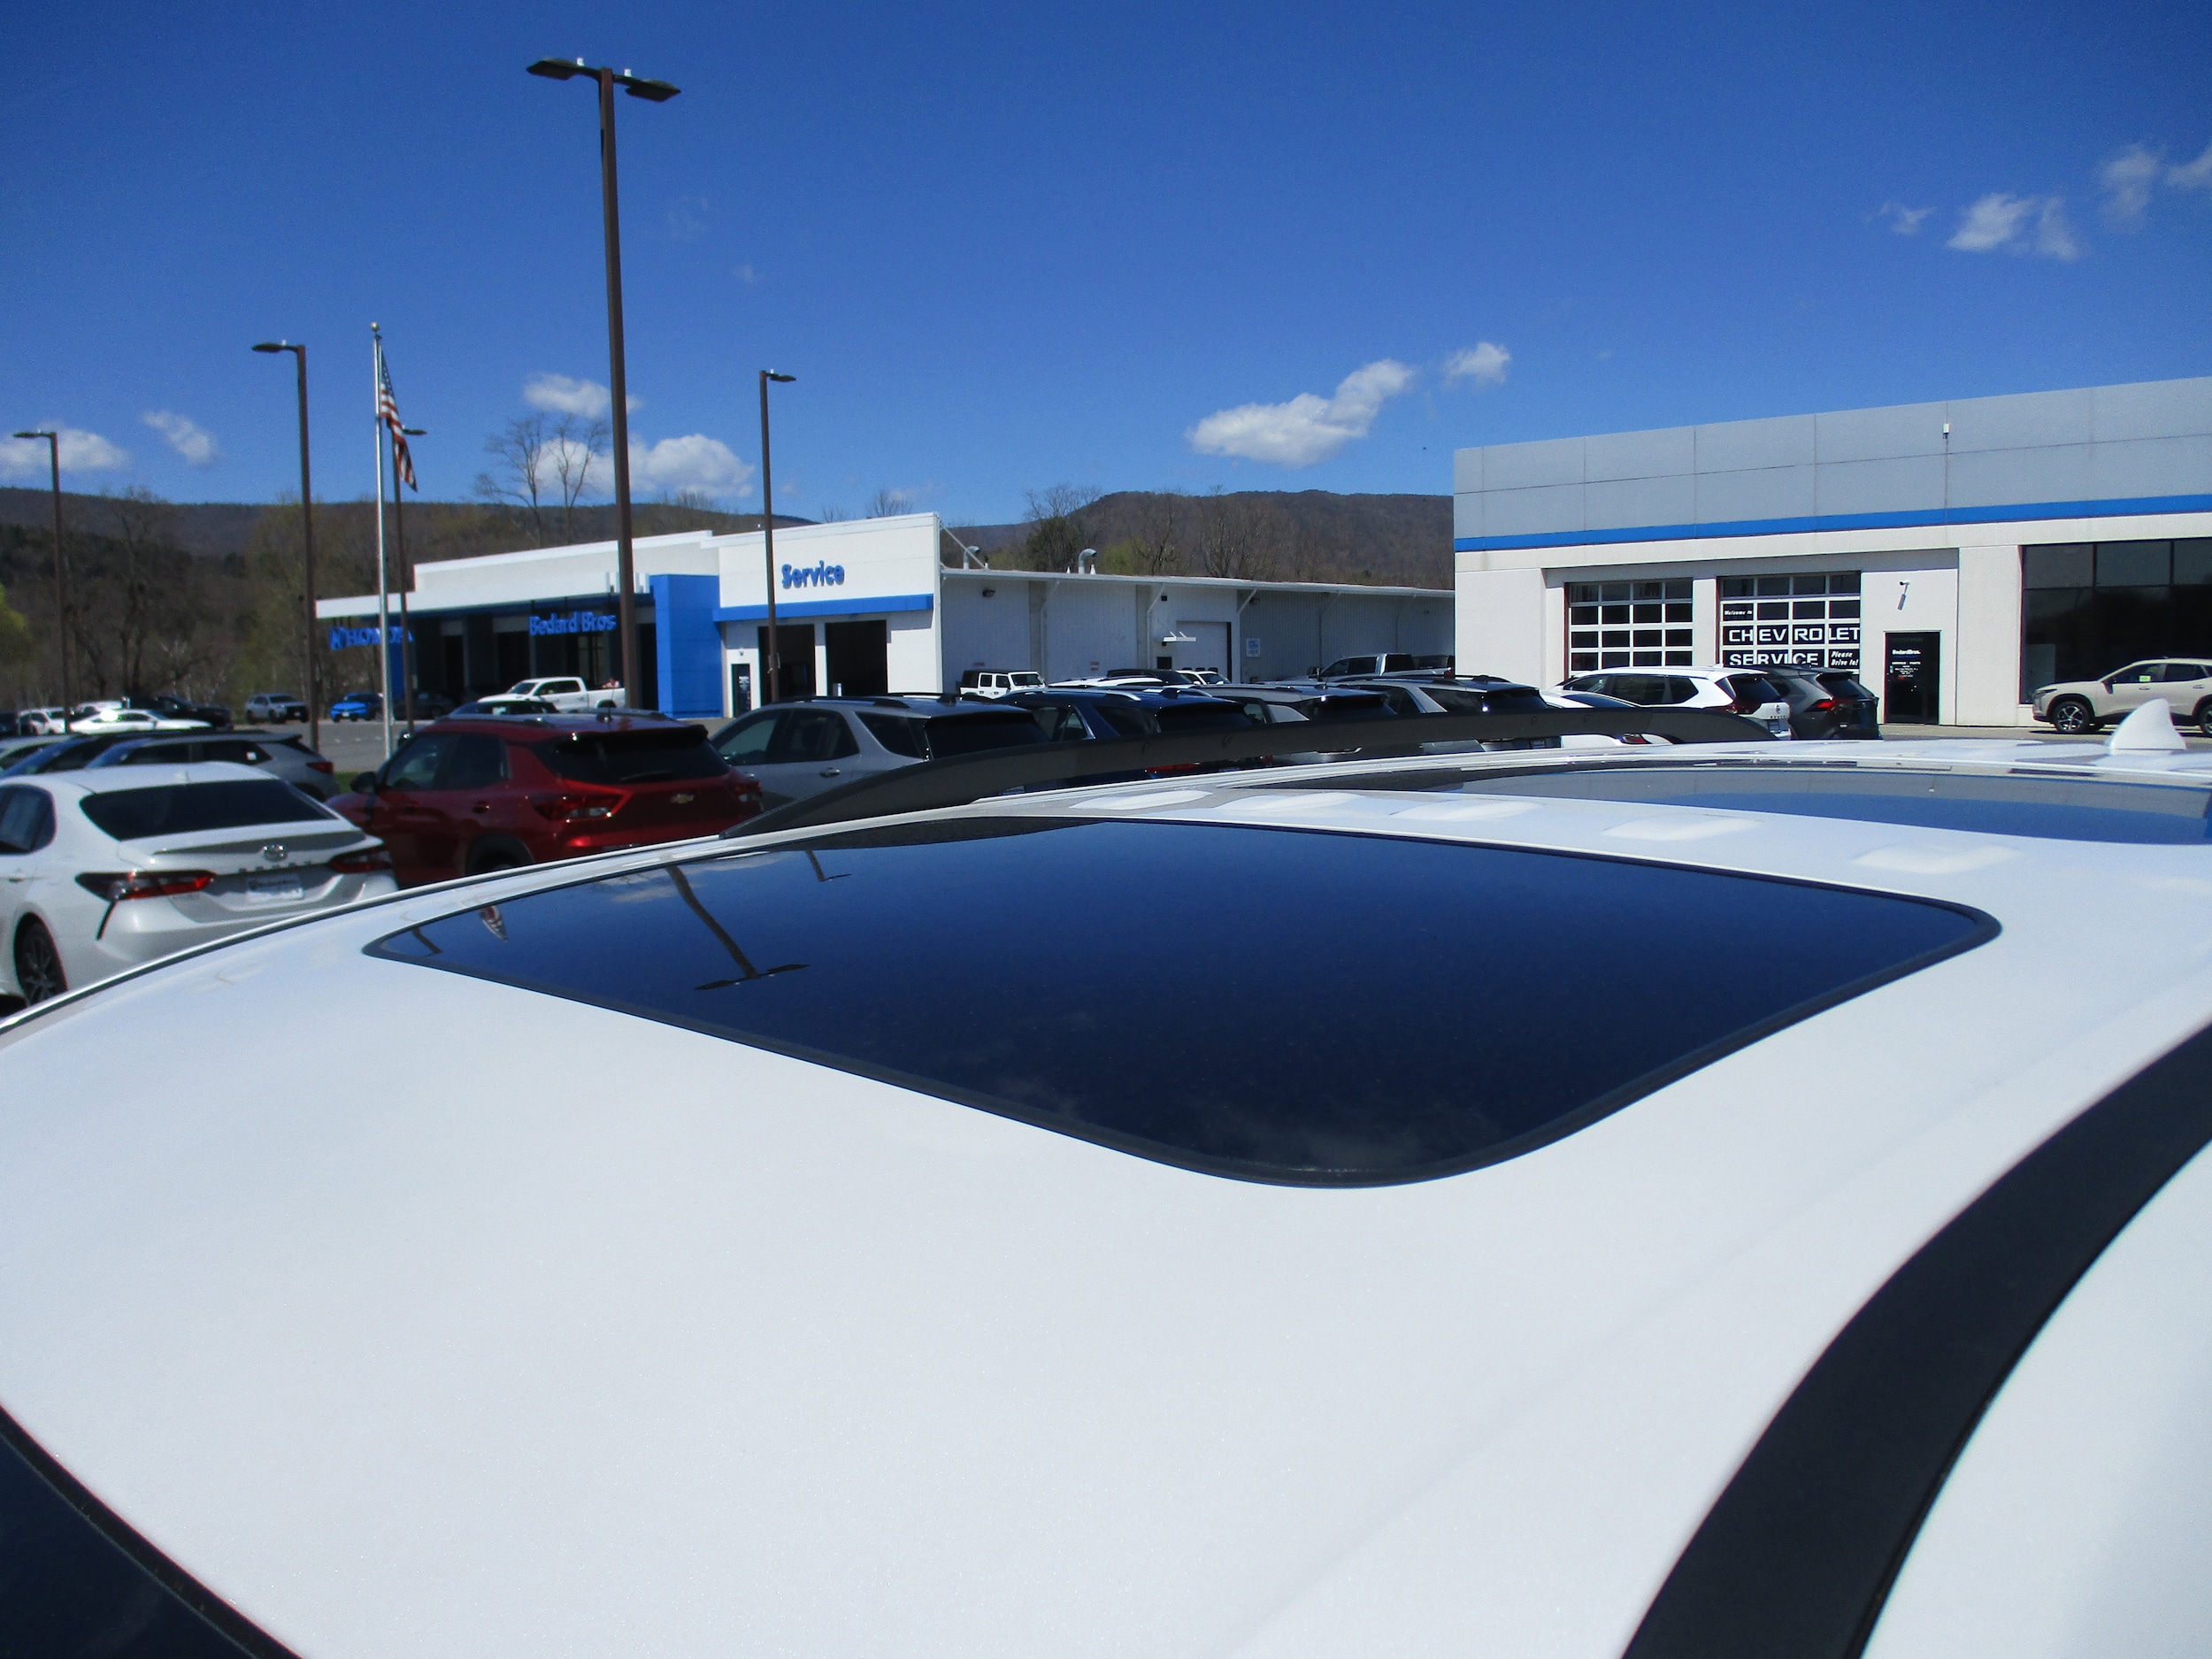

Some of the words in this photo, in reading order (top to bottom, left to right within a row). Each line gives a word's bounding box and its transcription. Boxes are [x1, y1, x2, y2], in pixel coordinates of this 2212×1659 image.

[781, 560, 845, 589] Service
[529, 611, 580, 635] Bedard
[581, 611, 617, 632] Bros
[1729, 627, 1860, 641] CHEVROLET
[1730, 653, 1819, 665] SERVICE
